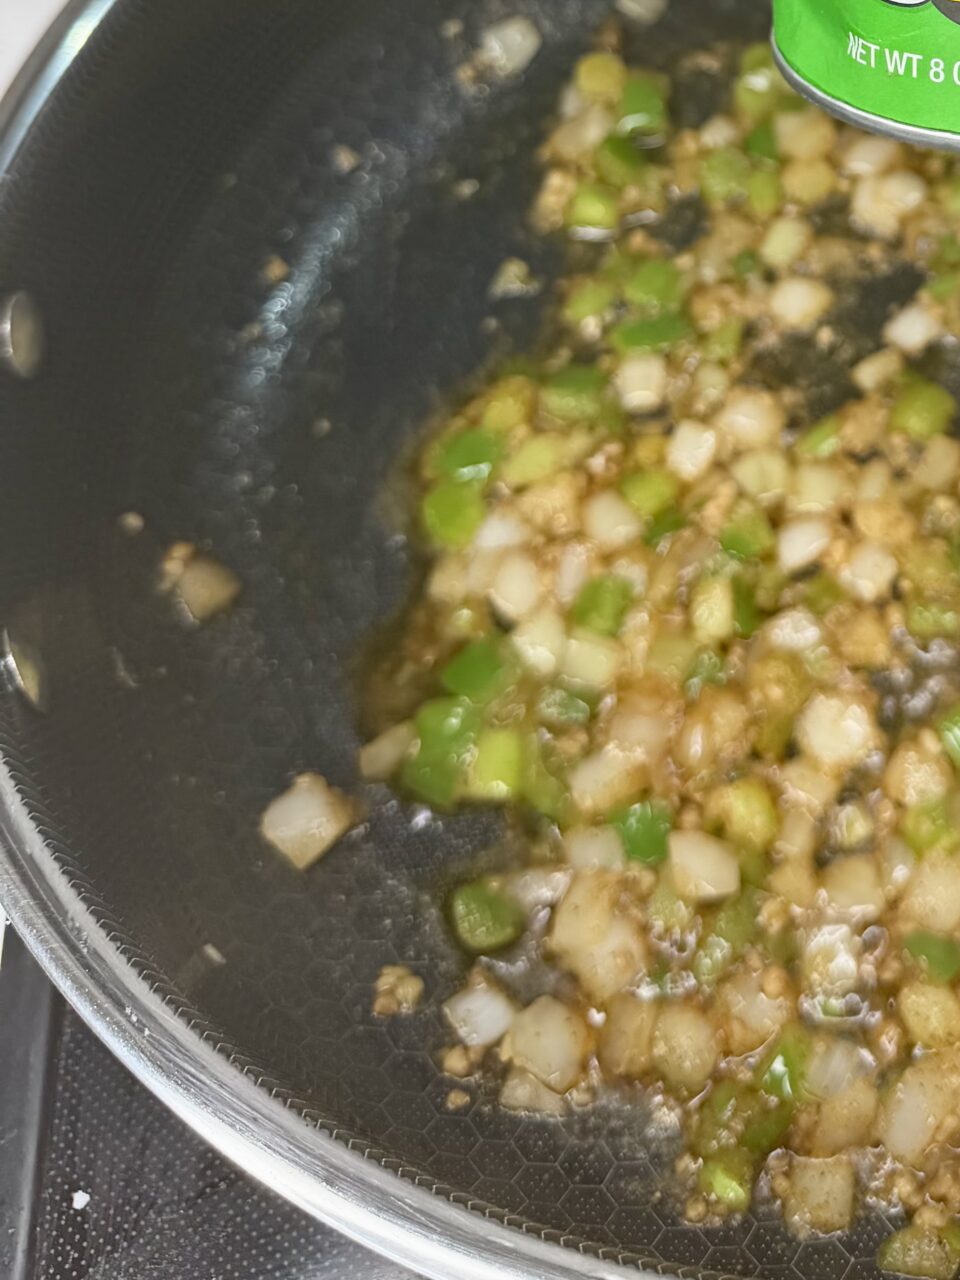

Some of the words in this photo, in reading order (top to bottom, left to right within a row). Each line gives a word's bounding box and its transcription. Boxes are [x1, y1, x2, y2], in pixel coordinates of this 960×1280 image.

[847, 31, 879, 69] NET
[884, 49, 924, 79] WT
[928, 57, 945, 83] 8
